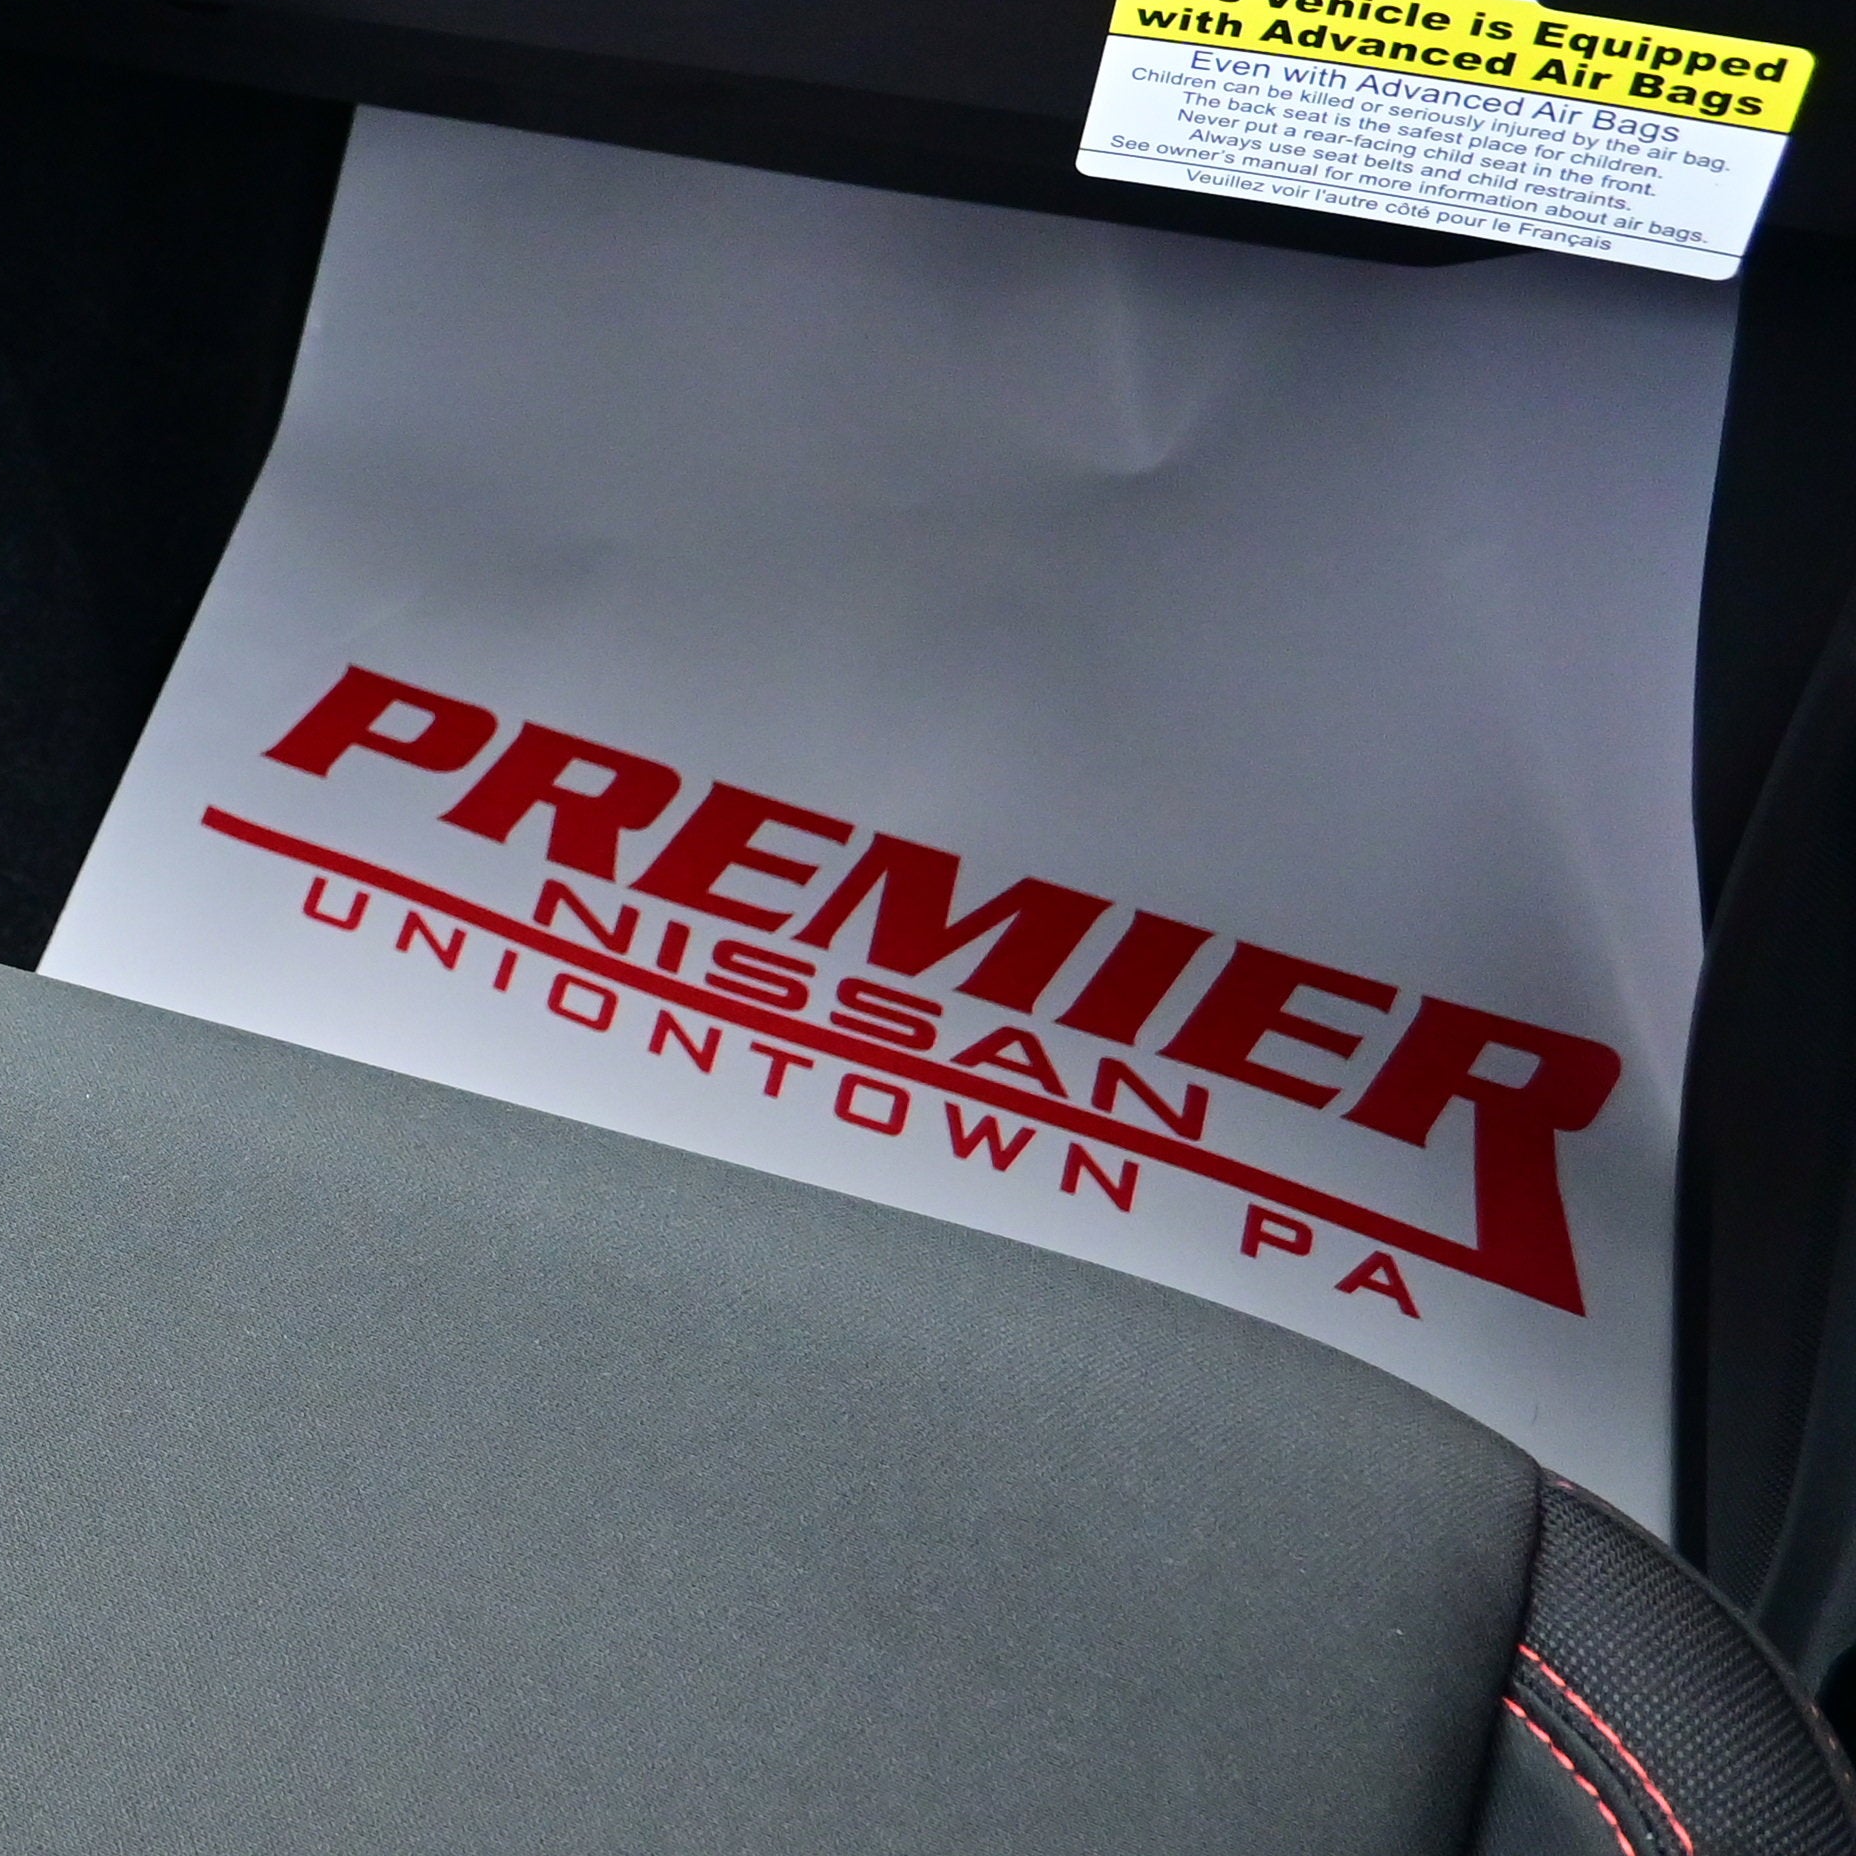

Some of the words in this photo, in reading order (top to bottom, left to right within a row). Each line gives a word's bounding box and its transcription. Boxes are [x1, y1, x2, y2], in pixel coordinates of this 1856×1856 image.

[1137, 7, 1243, 38] with
[1258, 19, 1518, 77] Advanced
[1531, 58, 1613, 90] Air
[1628, 72, 1765, 117] Bags
[1190, 49, 1271, 79] Even
[1284, 66, 1347, 90] with
[1355, 74, 1525, 117] Advanced
[1531, 100, 1583, 126] Air
[1592, 109, 1680, 143] Bags
[1469, 12, 1514, 40] is
[1533, 20, 1788, 83] Equipped
[1131, 67, 1216, 90] Children
[1223, 81, 1260, 96] can
[1267, 84, 1293, 100] be
[1300, 89, 1354, 109] killed
[1360, 100, 1383, 113] or
[1388, 104, 1485, 132] seriously
[1490, 119, 1565, 143] injured
[1572, 132, 1599, 150] by
[1605, 136, 1640, 155] the
[1646, 148, 1678, 164] air
[1683, 150, 1730, 174] bag.
[1177, 108, 1240, 130] Never
[1244, 119, 1278, 135] put
[1303, 128, 1416, 158] rear-facing
[1424, 146, 1474, 165] child
[1479, 155, 1526, 174] seat
[1532, 163, 1553, 177] in
[1559, 166, 1593, 185] the
[1600, 174, 1656, 196] front.
[1183, 90, 1220, 108] The
[1228, 98, 1277, 116] back
[1282, 107, 1328, 124] seat
[1334, 114, 1351, 128] is
[1358, 116, 1391, 133] the
[1397, 122, 1465, 145] safest
[1468, 133, 1527, 156] place
[1534, 144, 1565, 161] for
[1570, 152, 1663, 179] children.
[1188, 128, 1262, 152] Always
[1269, 141, 1306, 157] use
[1312, 145, 1357, 165] seat
[1364, 154, 1414, 174] belts
[1420, 161, 1461, 181] and
[1467, 170, 1518, 191] child
[1524, 180, 1631, 211] restraints.
[1110, 134, 1150, 152] See
[1156, 143, 1235, 164] owner's
[1242, 153, 1318, 177] manual
[1324, 165, 1354, 182] for
[1358, 174, 1412, 192] more
[1418, 181, 1538, 213] information
[1545, 204, 1607, 226] about
[1613, 216, 1643, 231] air
[1648, 221, 1708, 244] bags.
[1186, 168, 1265, 193] Veuillez
[1271, 184, 1310, 200] voir
[1315, 189, 1378, 210] l'autre
[1385, 201, 1430, 219] côté
[1436, 210, 1486, 230] pour
[1492, 217, 1511, 233] le
[1518, 222, 1612, 250] Français
[261, 663, 1623, 1319] PREMIER
[532, 879, 1214, 1145] NISSAN
[300, 876, 1143, 1214] UNIONTOWN
[1238, 1203, 1422, 1320] PA
